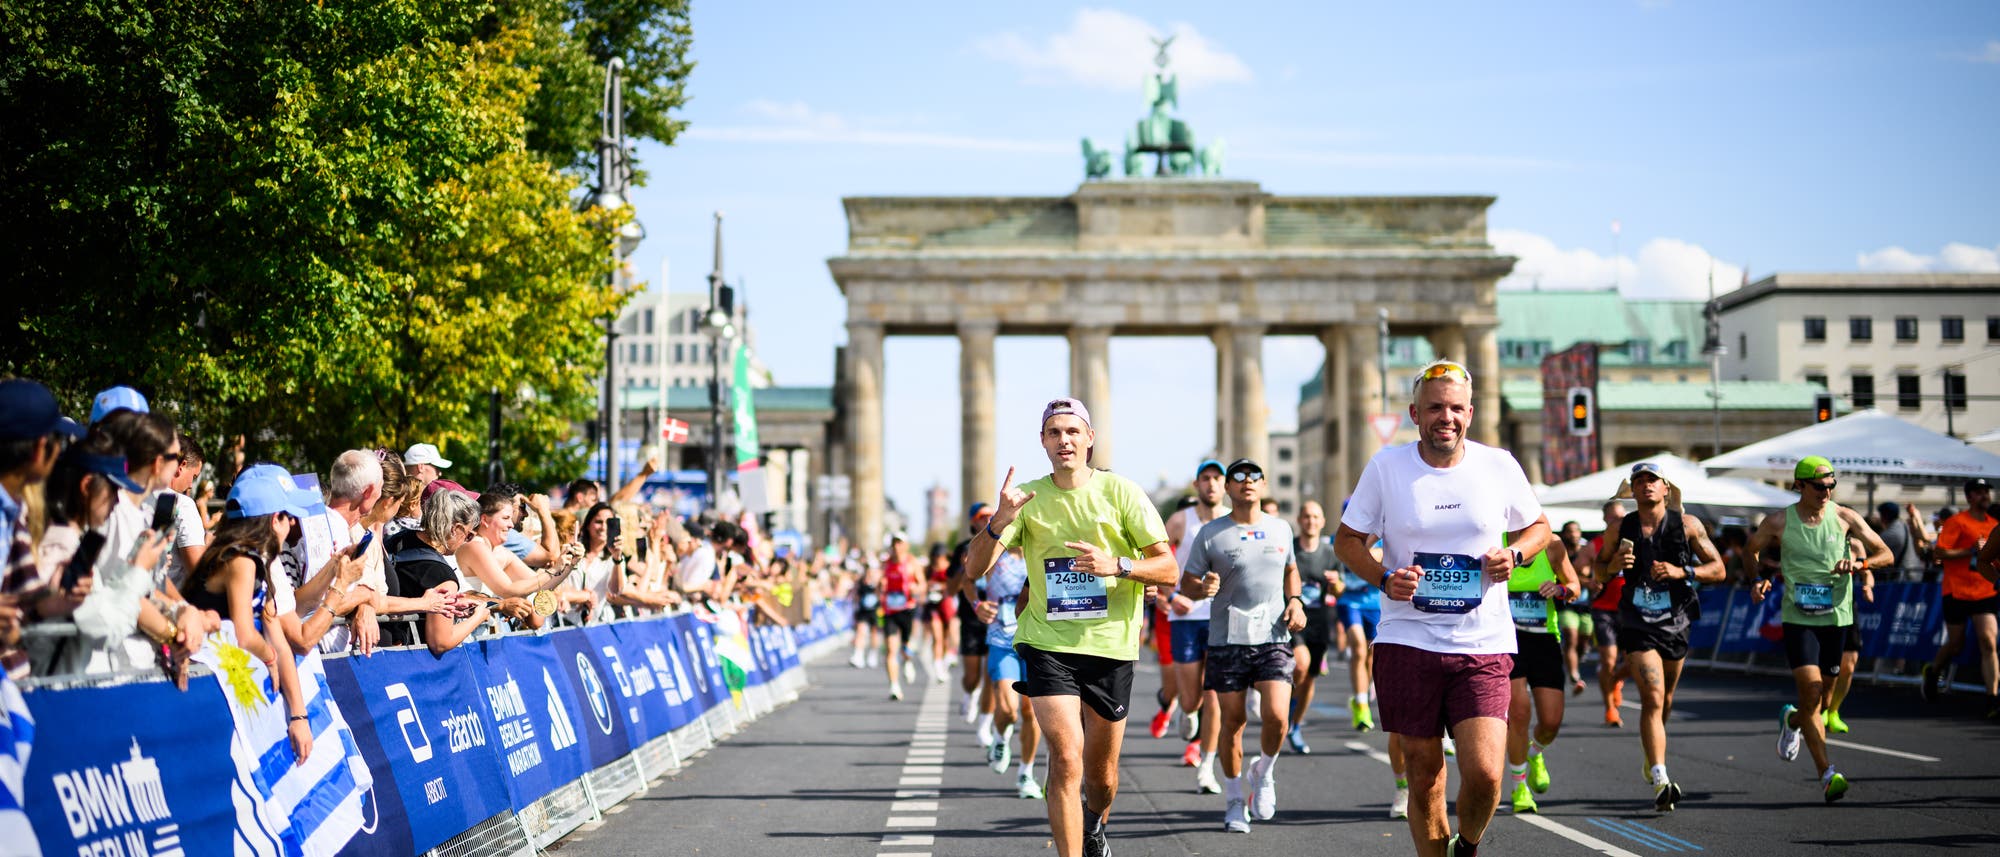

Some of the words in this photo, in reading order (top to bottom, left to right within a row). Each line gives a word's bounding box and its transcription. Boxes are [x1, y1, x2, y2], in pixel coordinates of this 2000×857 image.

[1055, 572, 1095, 585] 24306
[1424, 569, 1470, 583] 65993
[1431, 582, 1463, 592] Siegfried
[1060, 597, 1093, 606] zalando
[1428, 598, 1465, 607] zalando
[486, 683, 517, 722] BMW
[440, 705, 486, 754] zalando
[498, 719, 525, 750] BERLIN
[507, 741, 543, 778] MARATHON
[52, 762, 134, 839] BMW
[424, 776, 448, 806] ABBOTT
